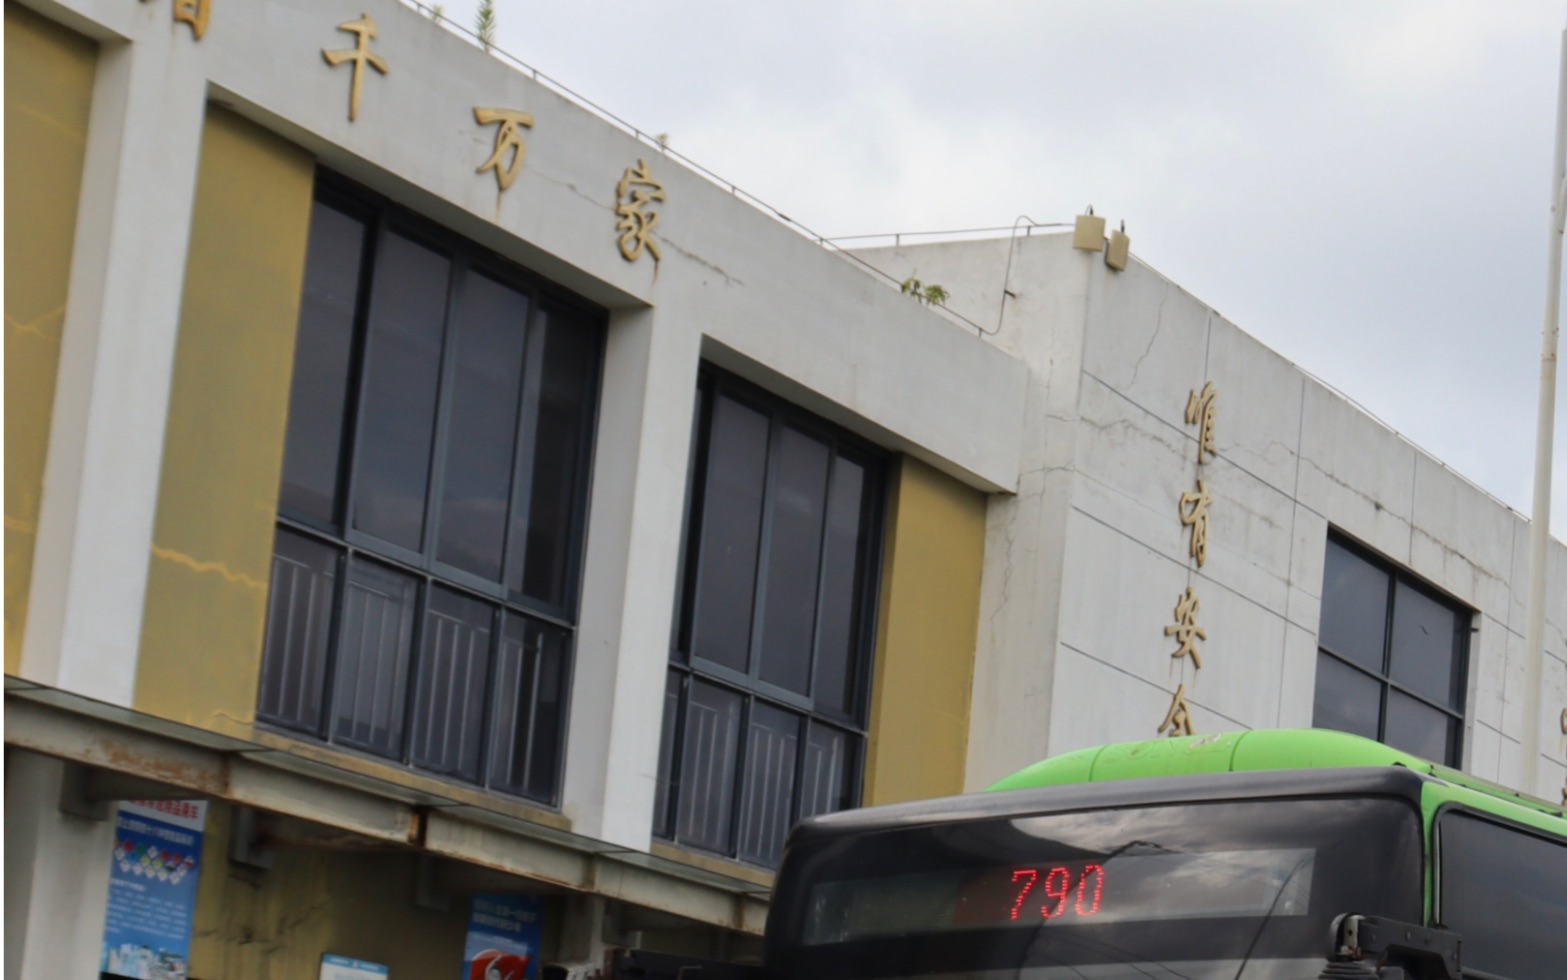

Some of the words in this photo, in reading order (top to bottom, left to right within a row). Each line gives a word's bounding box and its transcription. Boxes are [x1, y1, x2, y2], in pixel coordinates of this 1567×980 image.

[138, 0, 667, 263] 千万家
[1157, 380, 1218, 738] 唯有安全
[1009, 863, 1105, 922] 790
